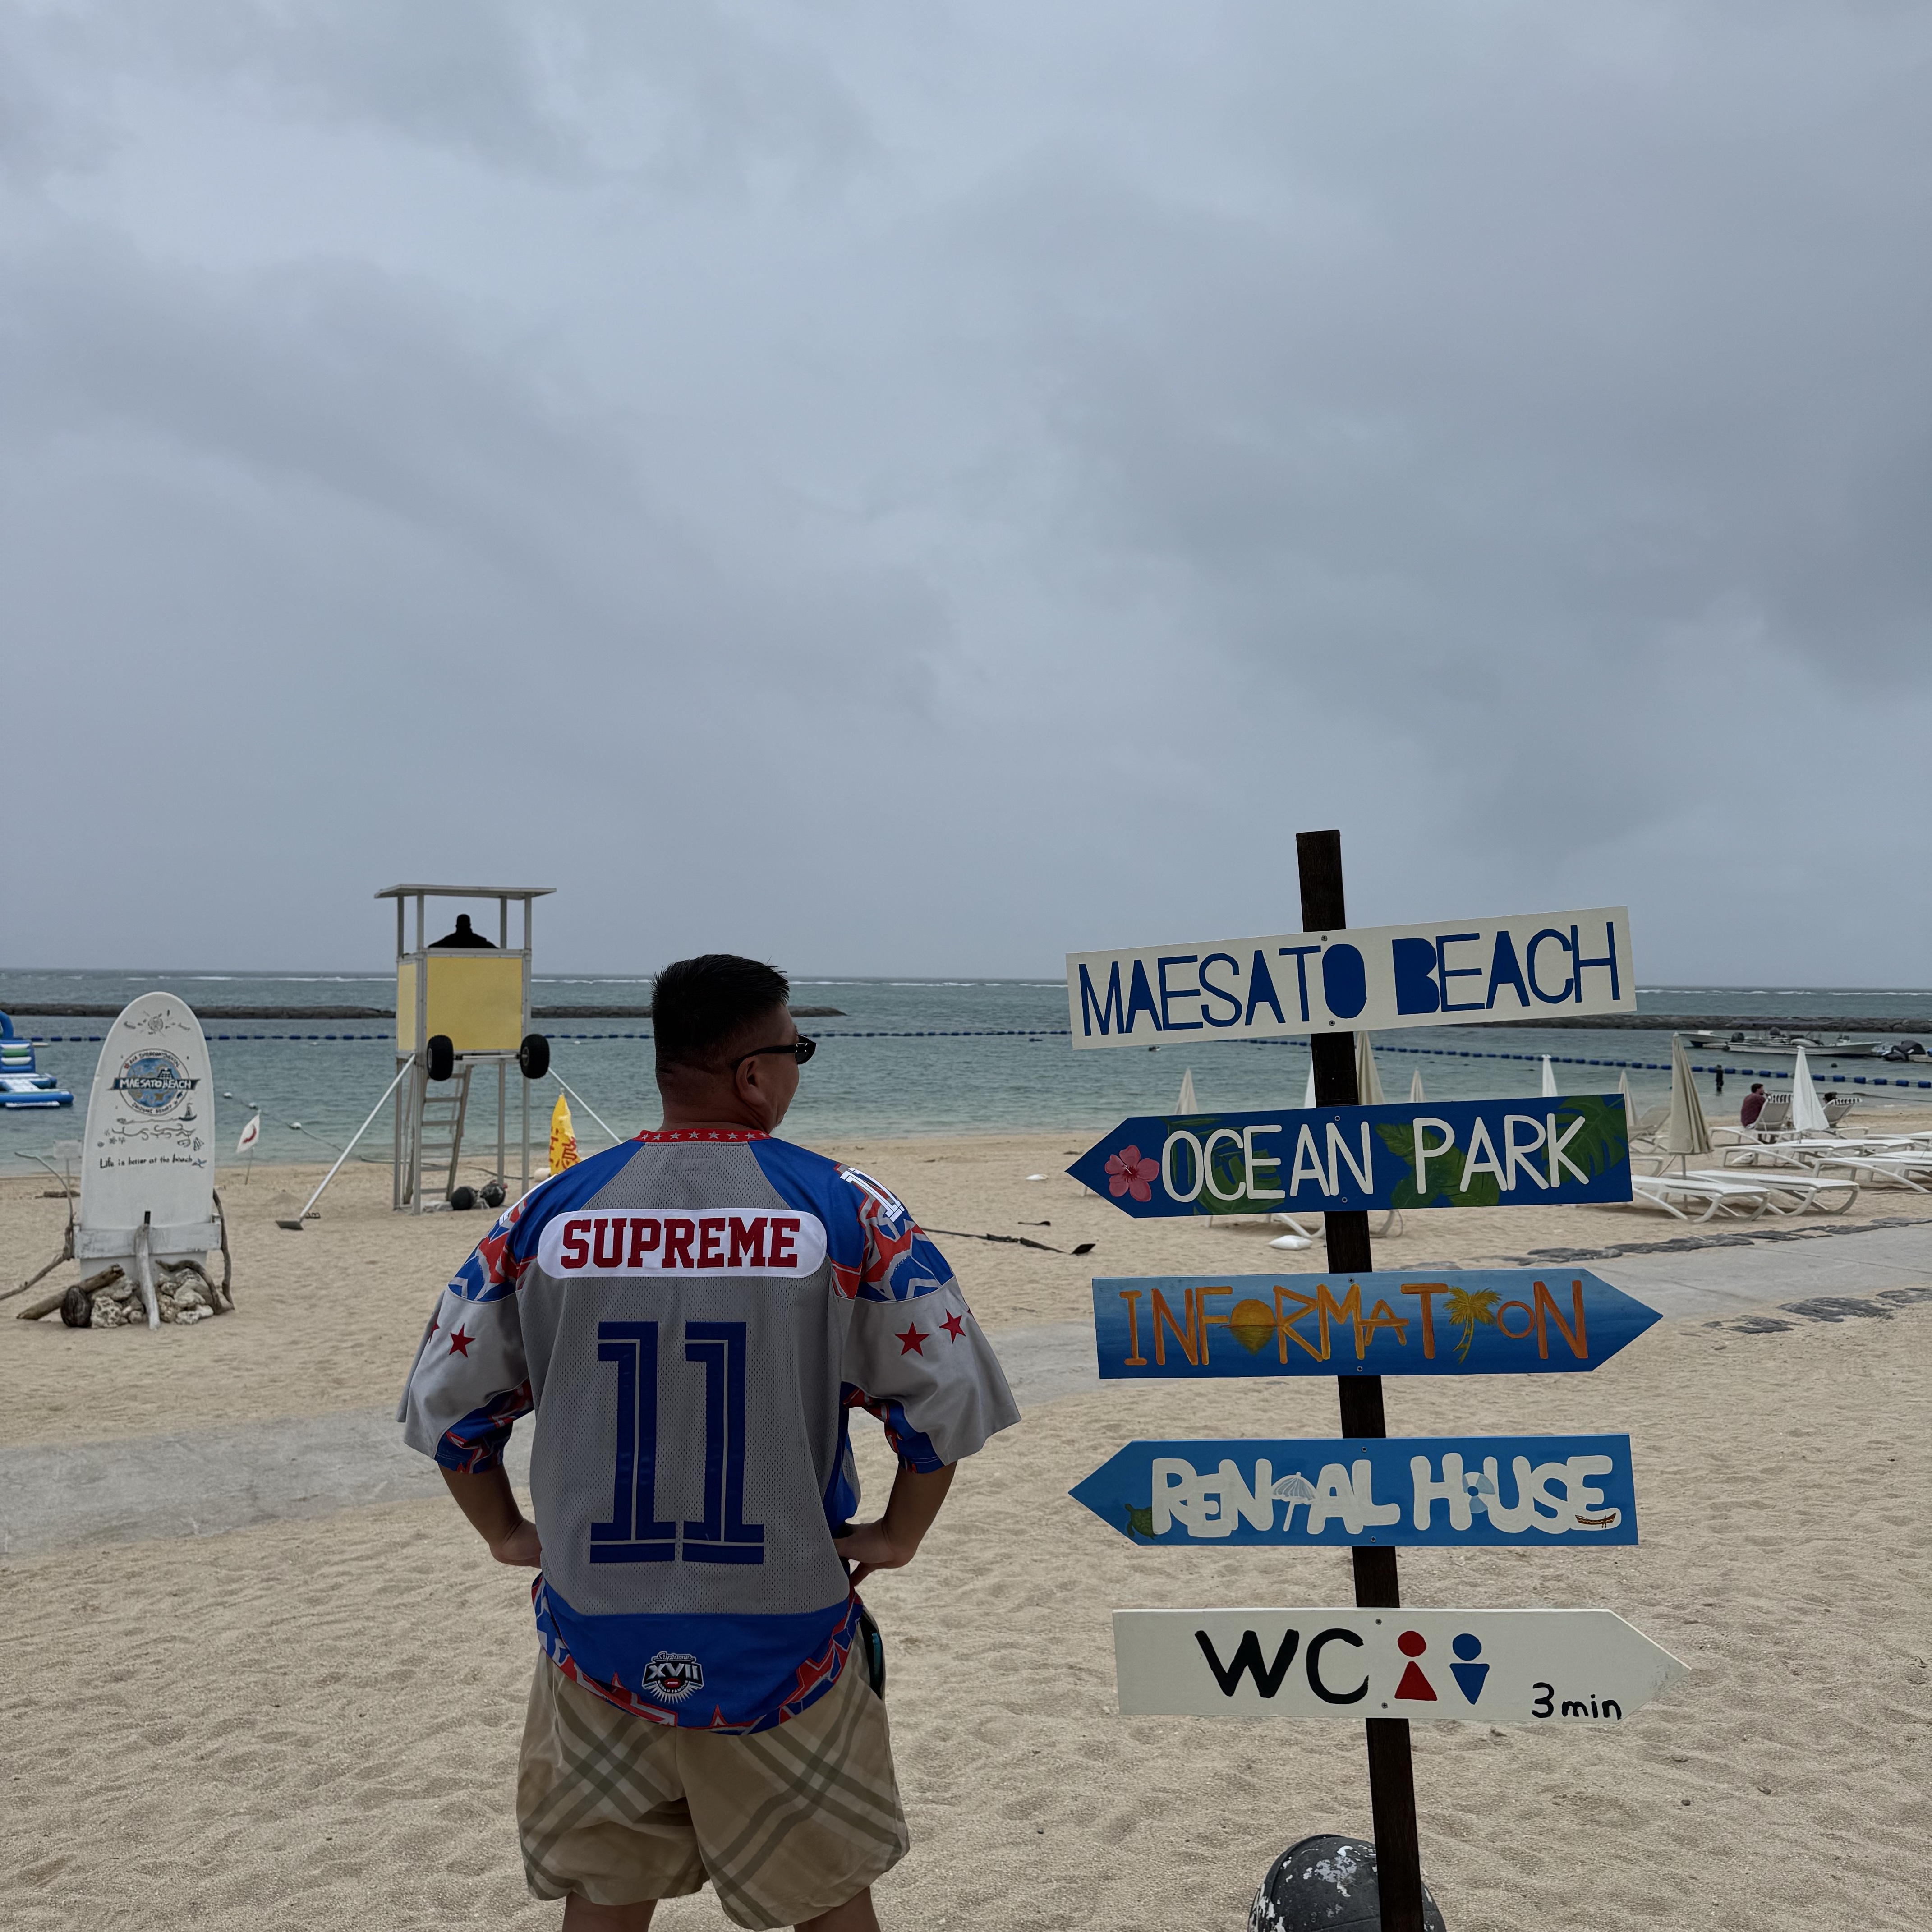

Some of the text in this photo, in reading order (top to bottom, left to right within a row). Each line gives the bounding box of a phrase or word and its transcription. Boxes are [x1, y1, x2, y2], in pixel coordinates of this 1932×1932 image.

[1079, 922, 1620, 1036] MAESATO BEACH
[120, 1078, 191, 1089] MAESATO BEACH
[1161, 1113, 1589, 1202] OCEAN PARK
[560, 1217, 800, 1269] SUPREME
[590, 1321, 765, 1564] 11
[646, 1663, 699, 1681] XVII
[658, 1652, 690, 1663] Supreme
[1194, 1628, 1369, 1705] WC
